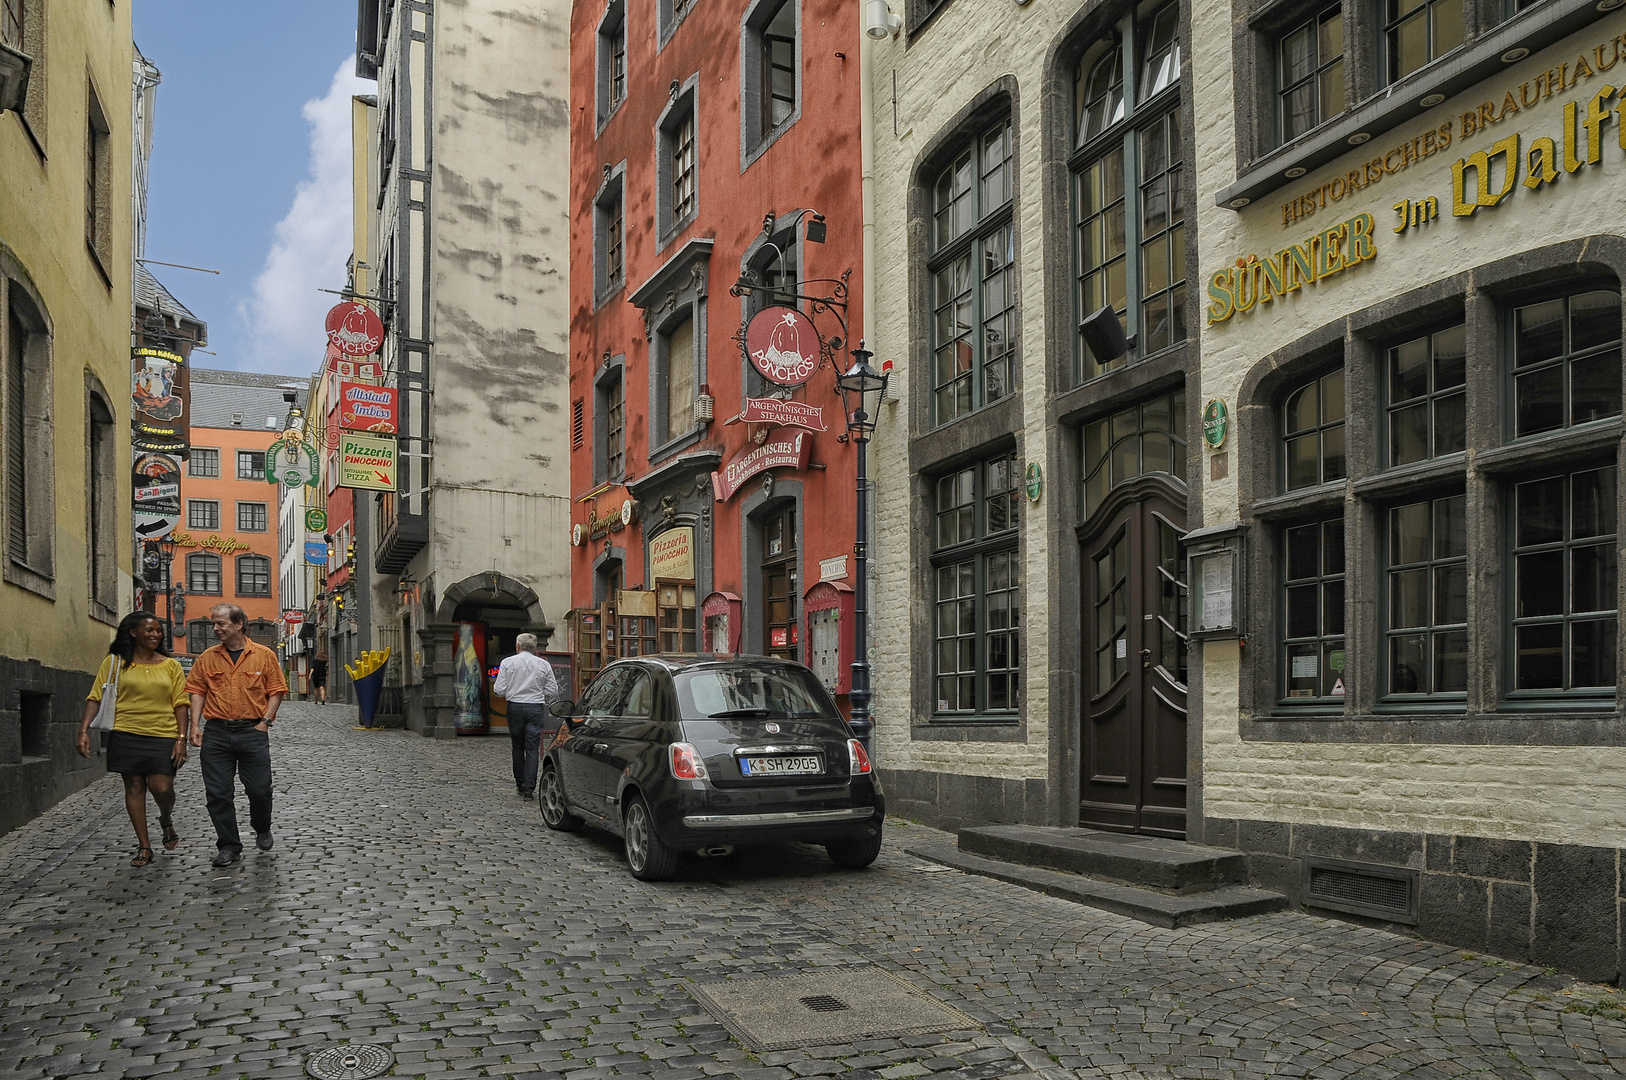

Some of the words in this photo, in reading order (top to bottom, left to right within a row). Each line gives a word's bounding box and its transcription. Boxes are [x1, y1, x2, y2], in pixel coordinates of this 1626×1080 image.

[1281, 121, 1452, 226] HISTORISCHES
[1206, 213, 1377, 325] SÜNNER
[346, 387, 391, 404] Altstadt
[353, 403, 391, 419] Imbiss
[749, 401, 820, 417] ARGENTINISCHES
[760, 411, 808, 424] STEAKHAUS
[135, 422, 174, 435] Taverna
[345, 442, 393, 458] Pizzeria
[344, 456, 393, 467] PINOCCHIO
[735, 442, 793, 477] ARGENTINISCHES
[346, 473, 371, 482] PIZZA
[152, 486, 177, 497] Miguel
[654, 532, 688, 555] Pizzeria
[652, 545, 689, 566] PINOCCHIO
[749, 760, 759, 771] K
[766, 758, 784, 771] SH
[785, 758, 818, 770] 2905
